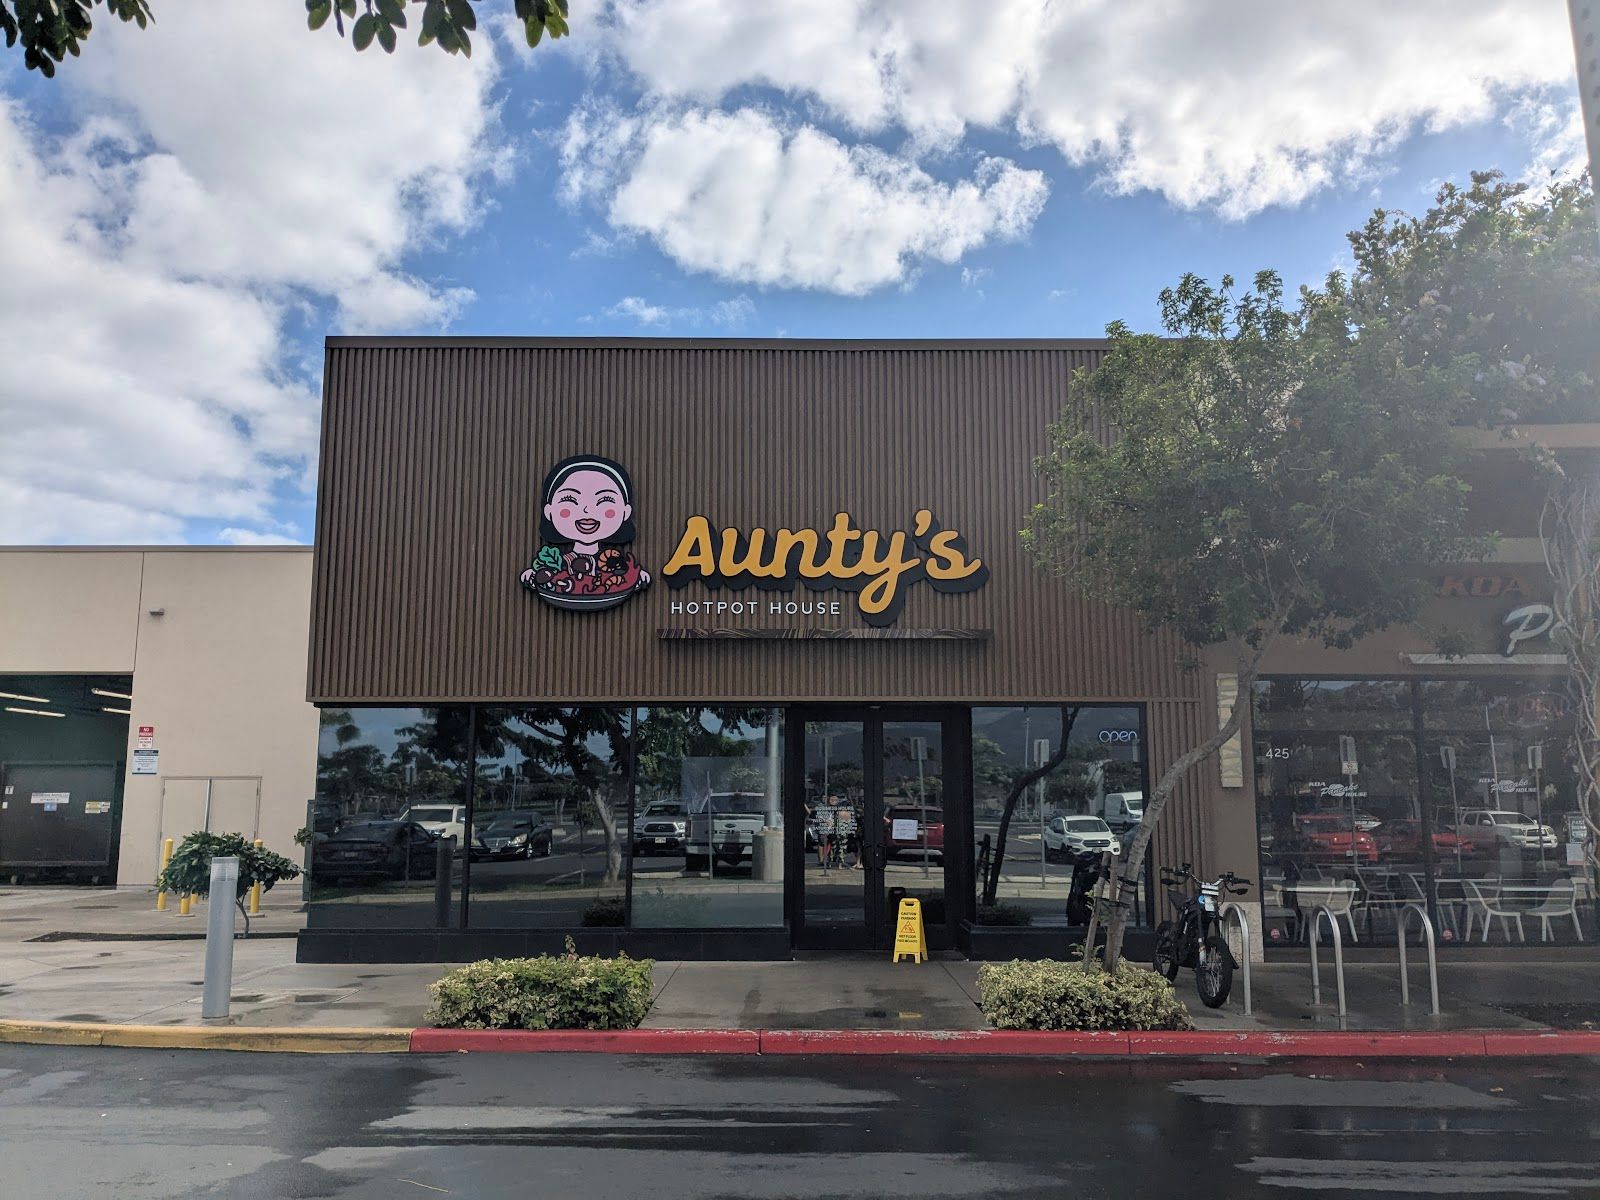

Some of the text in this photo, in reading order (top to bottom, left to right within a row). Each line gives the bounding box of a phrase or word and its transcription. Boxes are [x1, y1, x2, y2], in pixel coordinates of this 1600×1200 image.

[664, 509, 980, 613] Aunty's
[671, 601, 840, 615] HOTPOT HOUSE
[1099, 730, 1138, 744] open
[1265, 748, 1290, 759] 425
